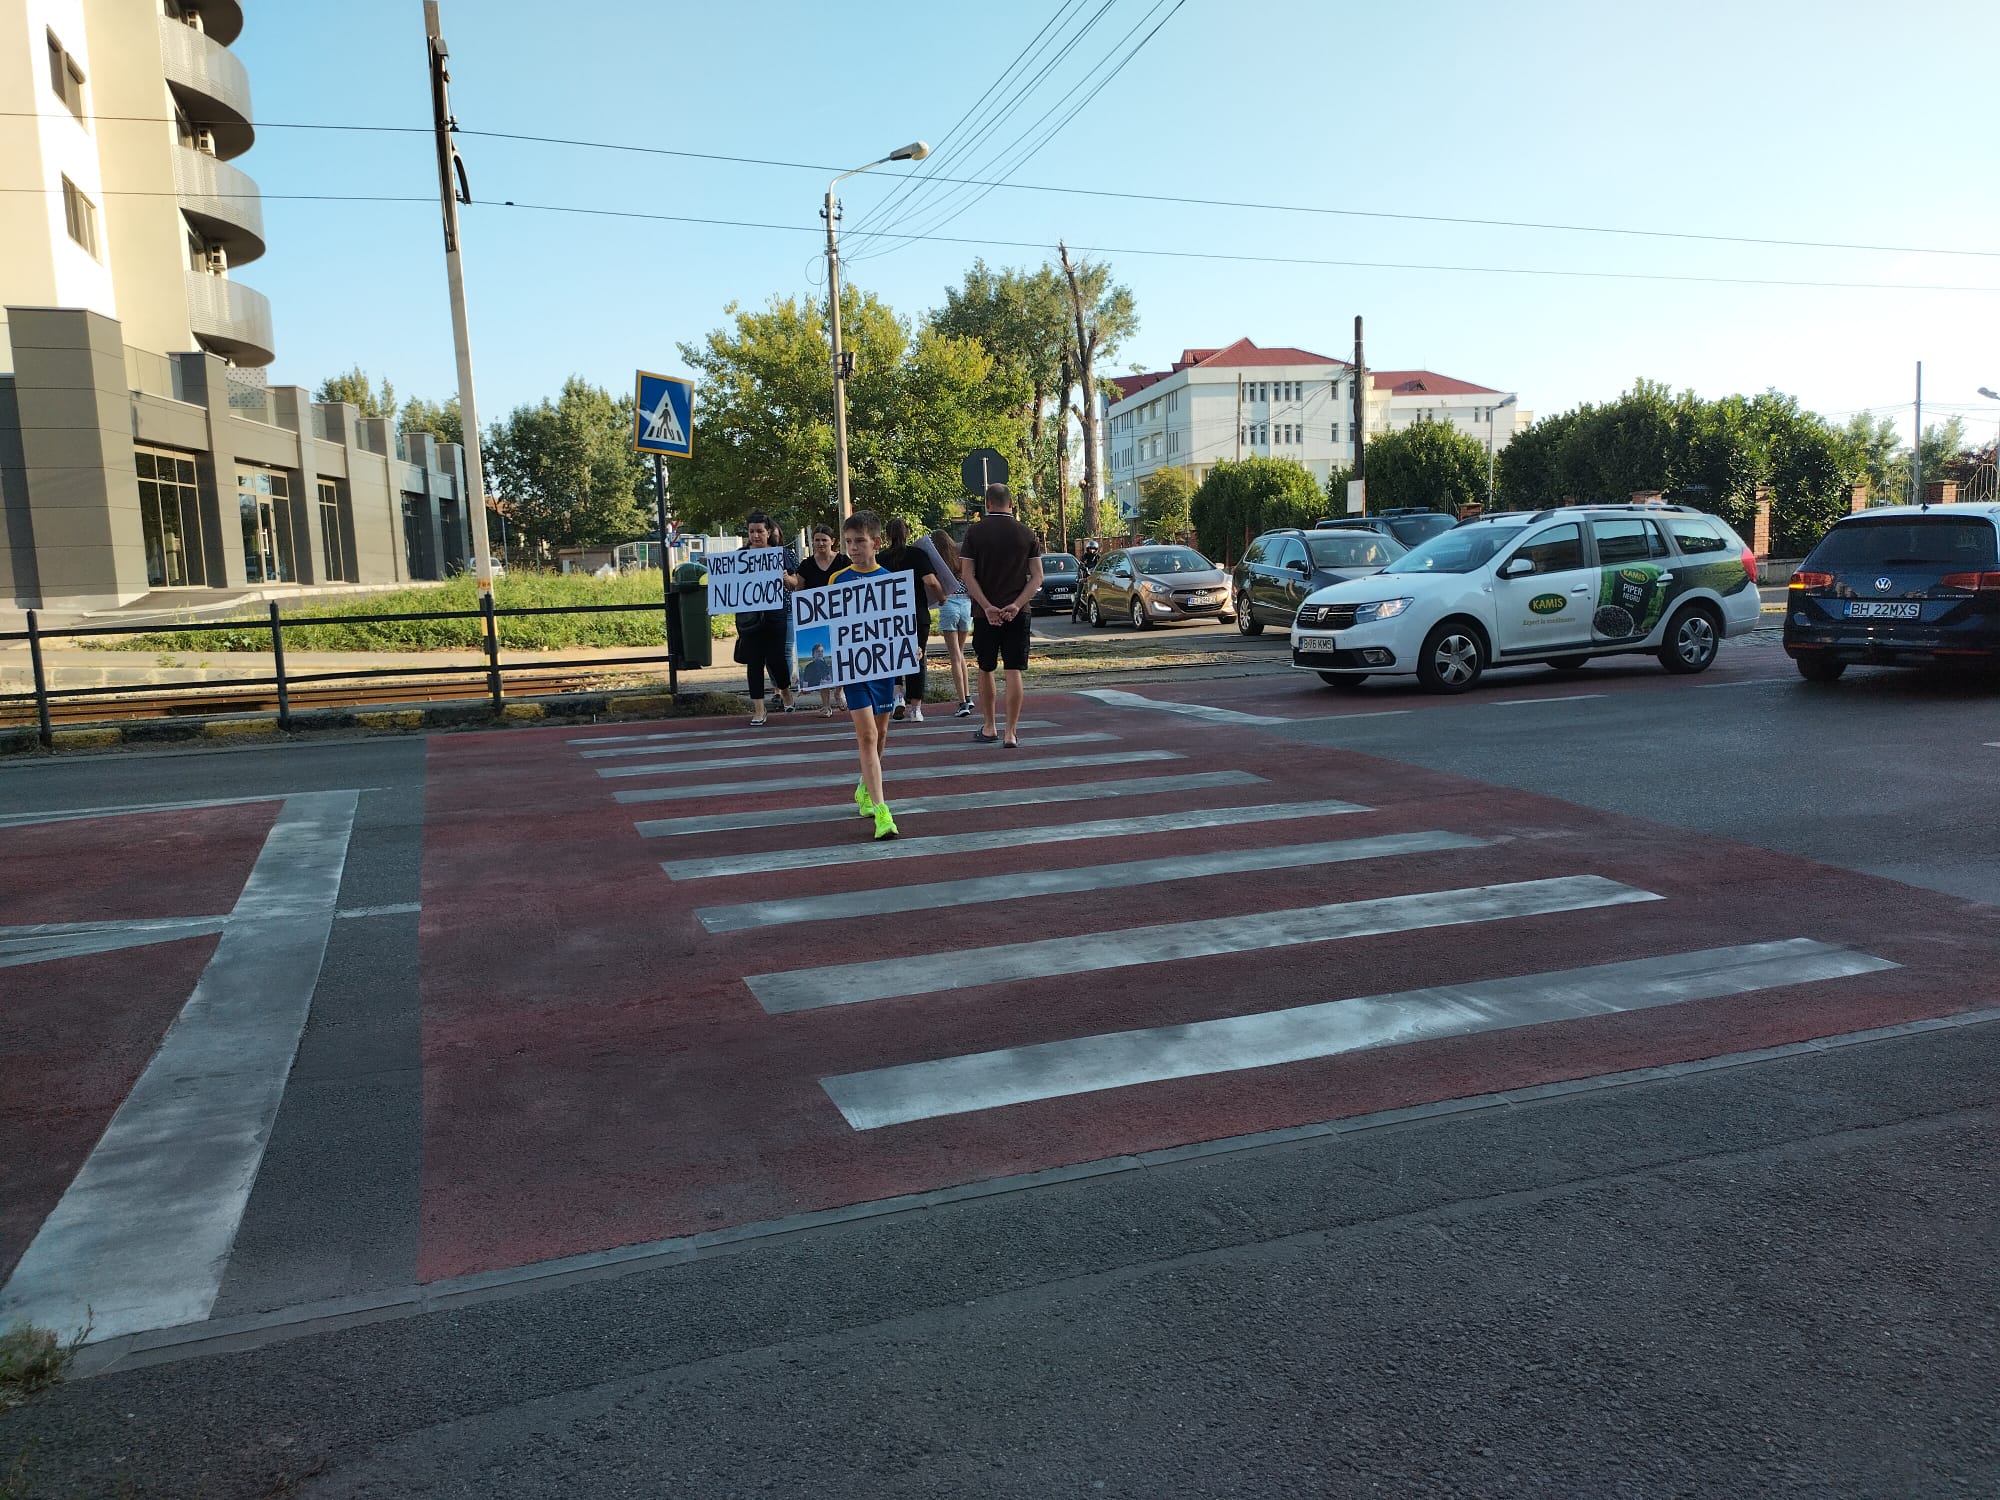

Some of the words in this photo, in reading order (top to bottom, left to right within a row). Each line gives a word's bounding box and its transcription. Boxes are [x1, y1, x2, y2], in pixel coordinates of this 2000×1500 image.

[708, 556, 736, 576] VREM
[738, 551, 784, 575] SEMAFOR
[714, 582, 740, 608] NU
[742, 578, 784, 606] COVOR
[796, 577, 908, 626] DREPTATE
[1623, 583, 1643, 597] PIPER
[1532, 598, 1564, 610] KAMIS
[1851, 603, 1869, 615] BH
[838, 613, 917, 647] PENTRU
